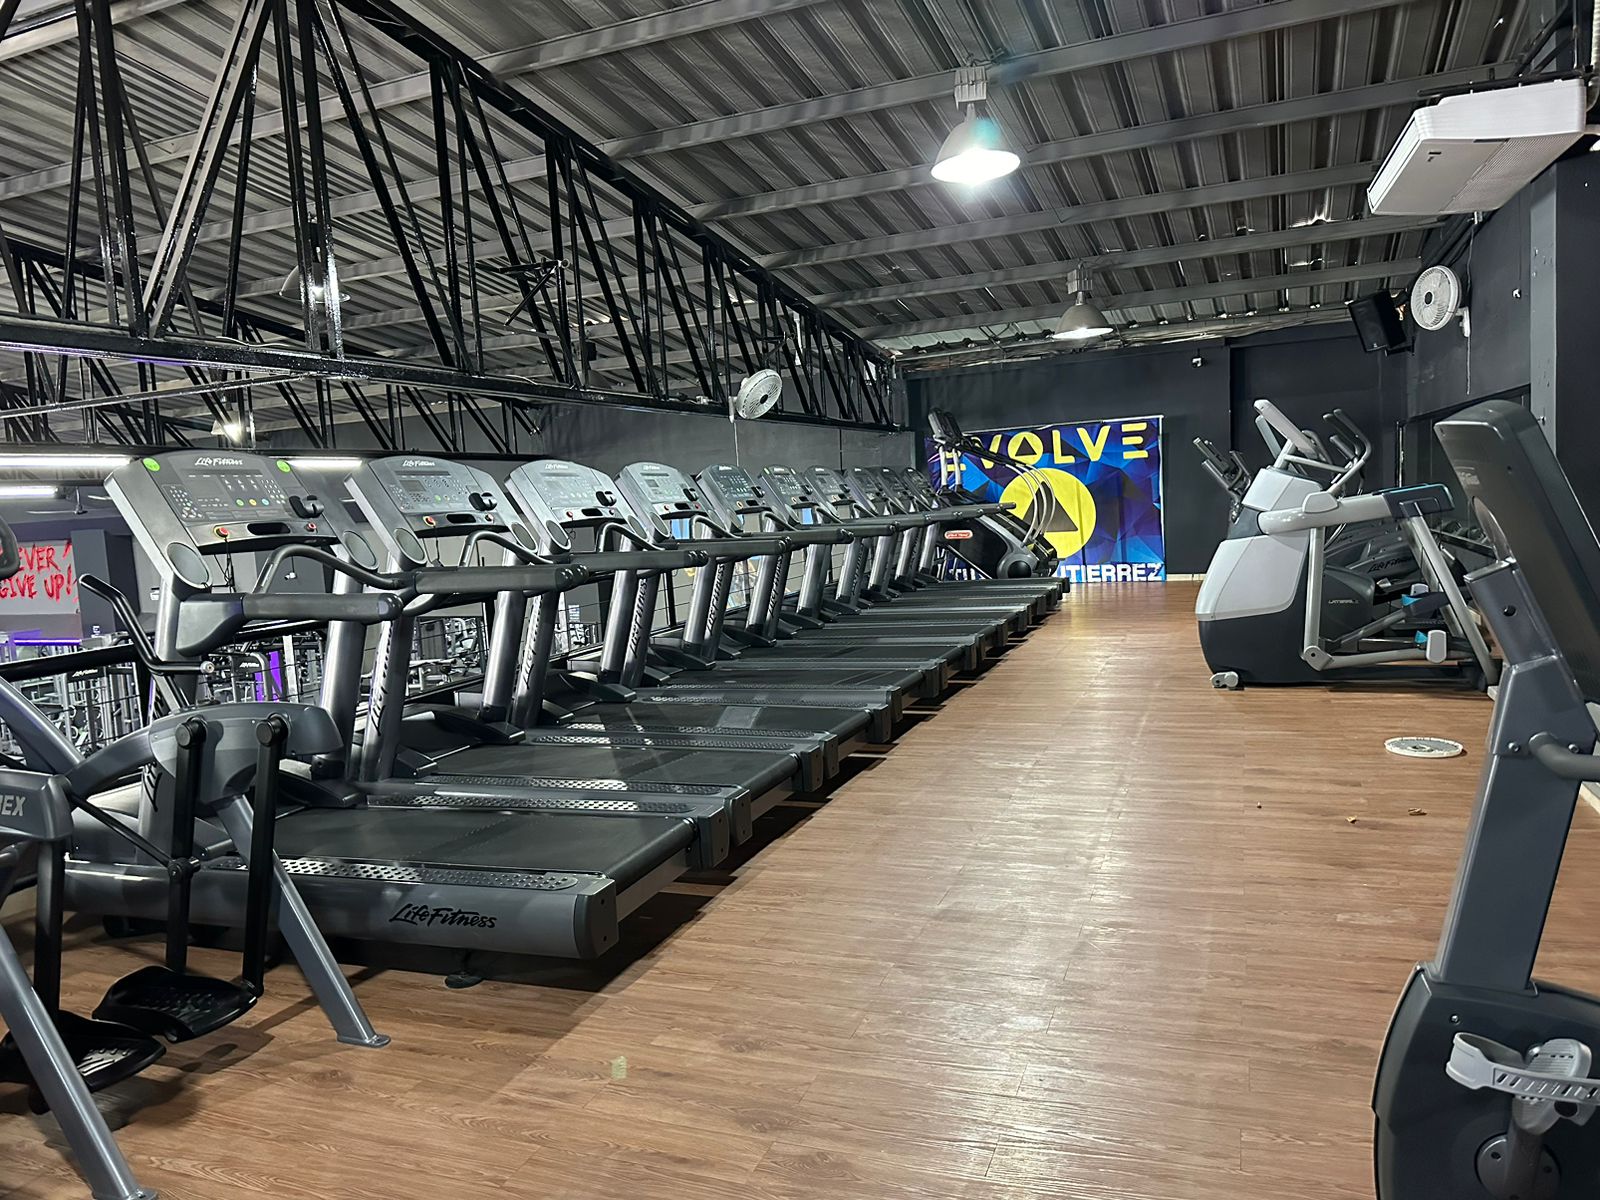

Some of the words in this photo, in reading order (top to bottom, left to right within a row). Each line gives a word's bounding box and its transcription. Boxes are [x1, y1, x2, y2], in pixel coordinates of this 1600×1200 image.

[17, 544, 61, 572] VER
[1052, 563, 1162, 582] UTIERREZ
[0, 794, 26, 817] EX
